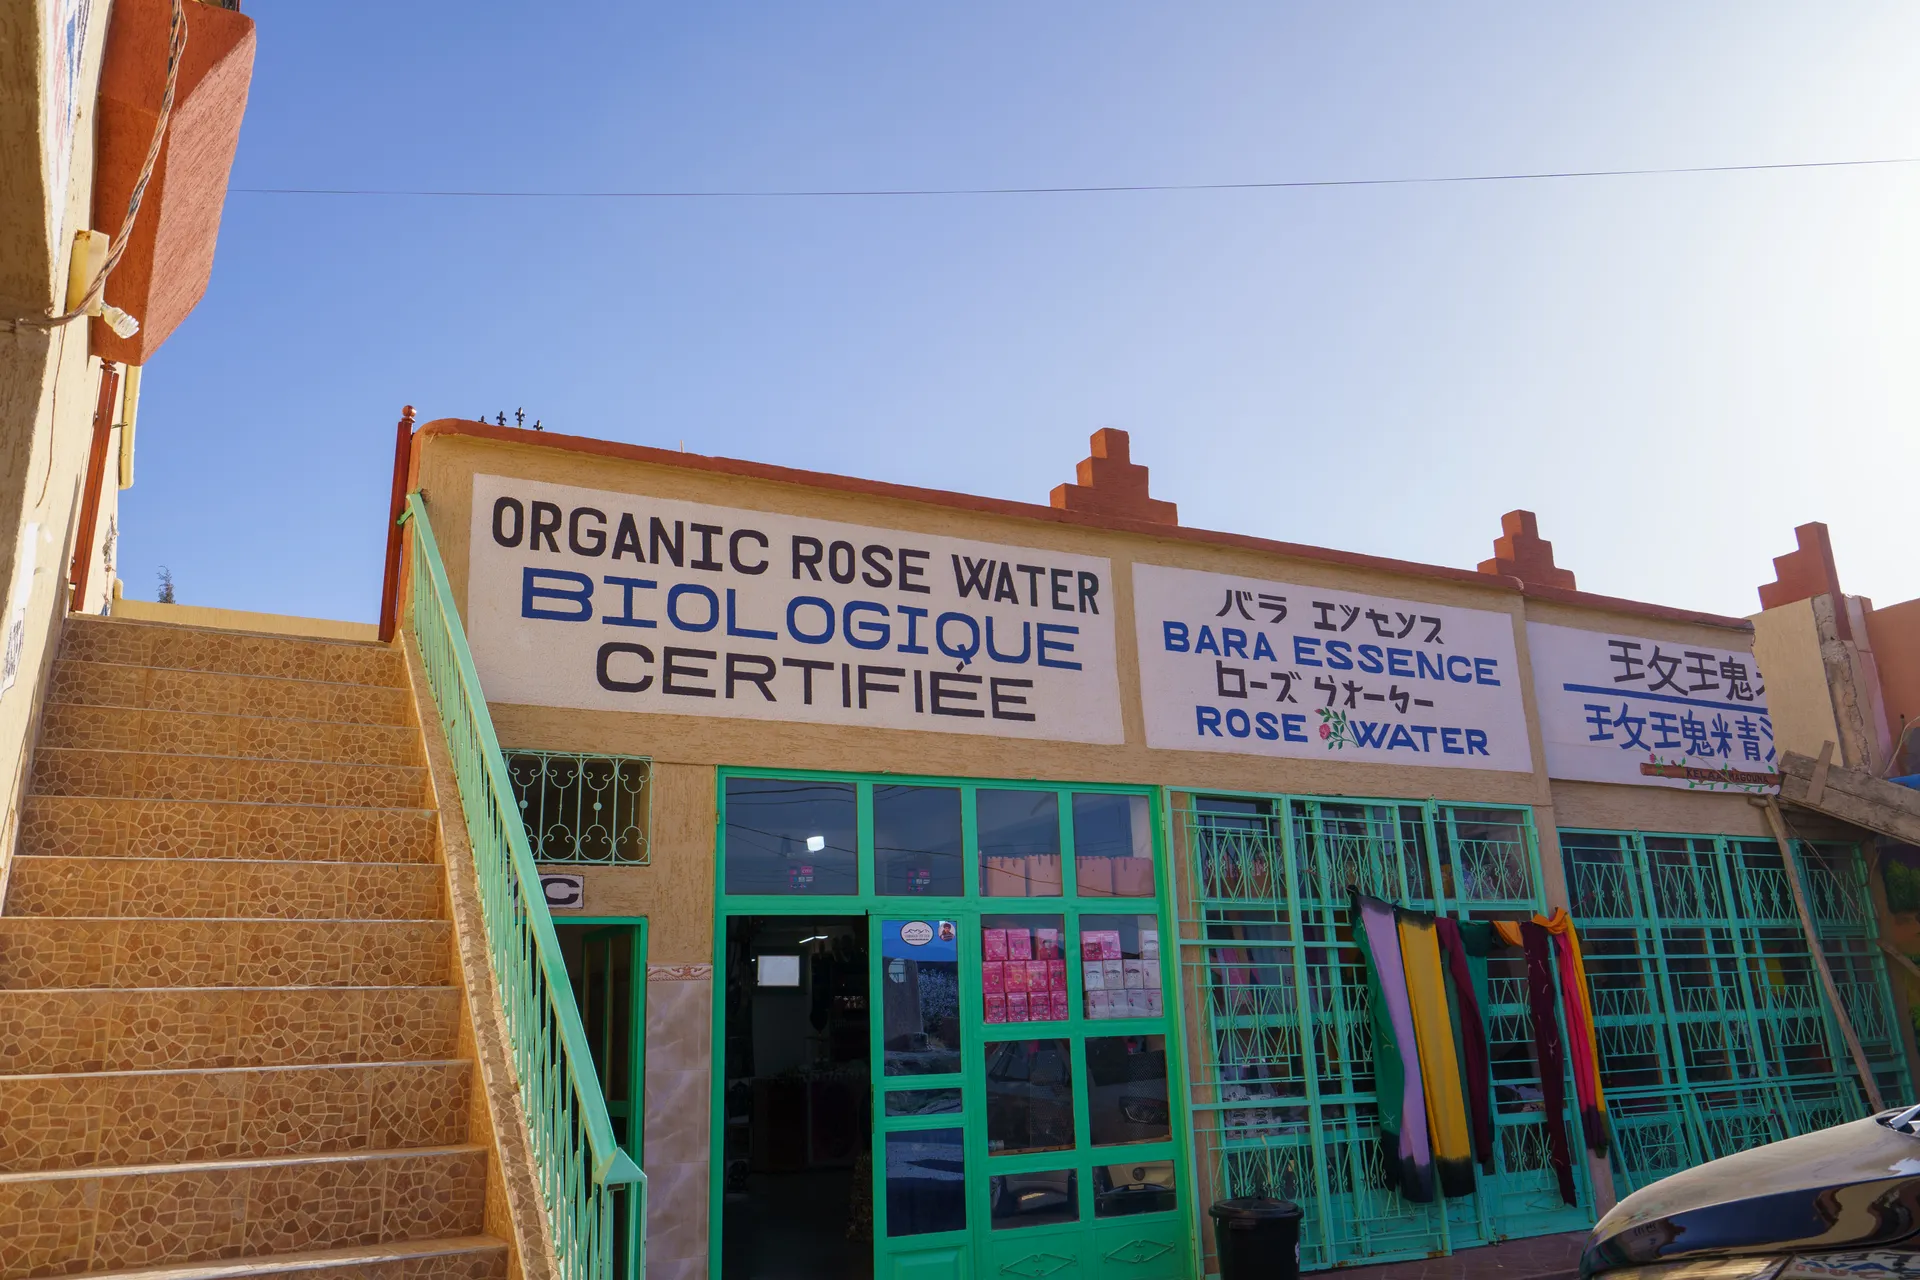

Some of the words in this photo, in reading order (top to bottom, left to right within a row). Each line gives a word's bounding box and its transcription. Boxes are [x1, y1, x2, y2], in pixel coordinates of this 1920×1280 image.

[492, 496, 769, 576] ORGANIC
[791, 534, 931, 595] ROSE
[951, 553, 1100, 615] WATER
[521, 566, 1083, 672] BIOLOGIQUE
[1215, 589, 1288, 624] バラ
[596, 641, 1036, 722] CERTIFIÉE
[1162, 620, 1277, 663] BARA
[1292, 635, 1502, 687] ESSENCE
[1215, 659, 1302, 704] ローズ
[1607, 639, 1766, 702] 玫瑰
[1195, 705, 1309, 743] ROSE
[1349, 719, 1491, 756] WATER
